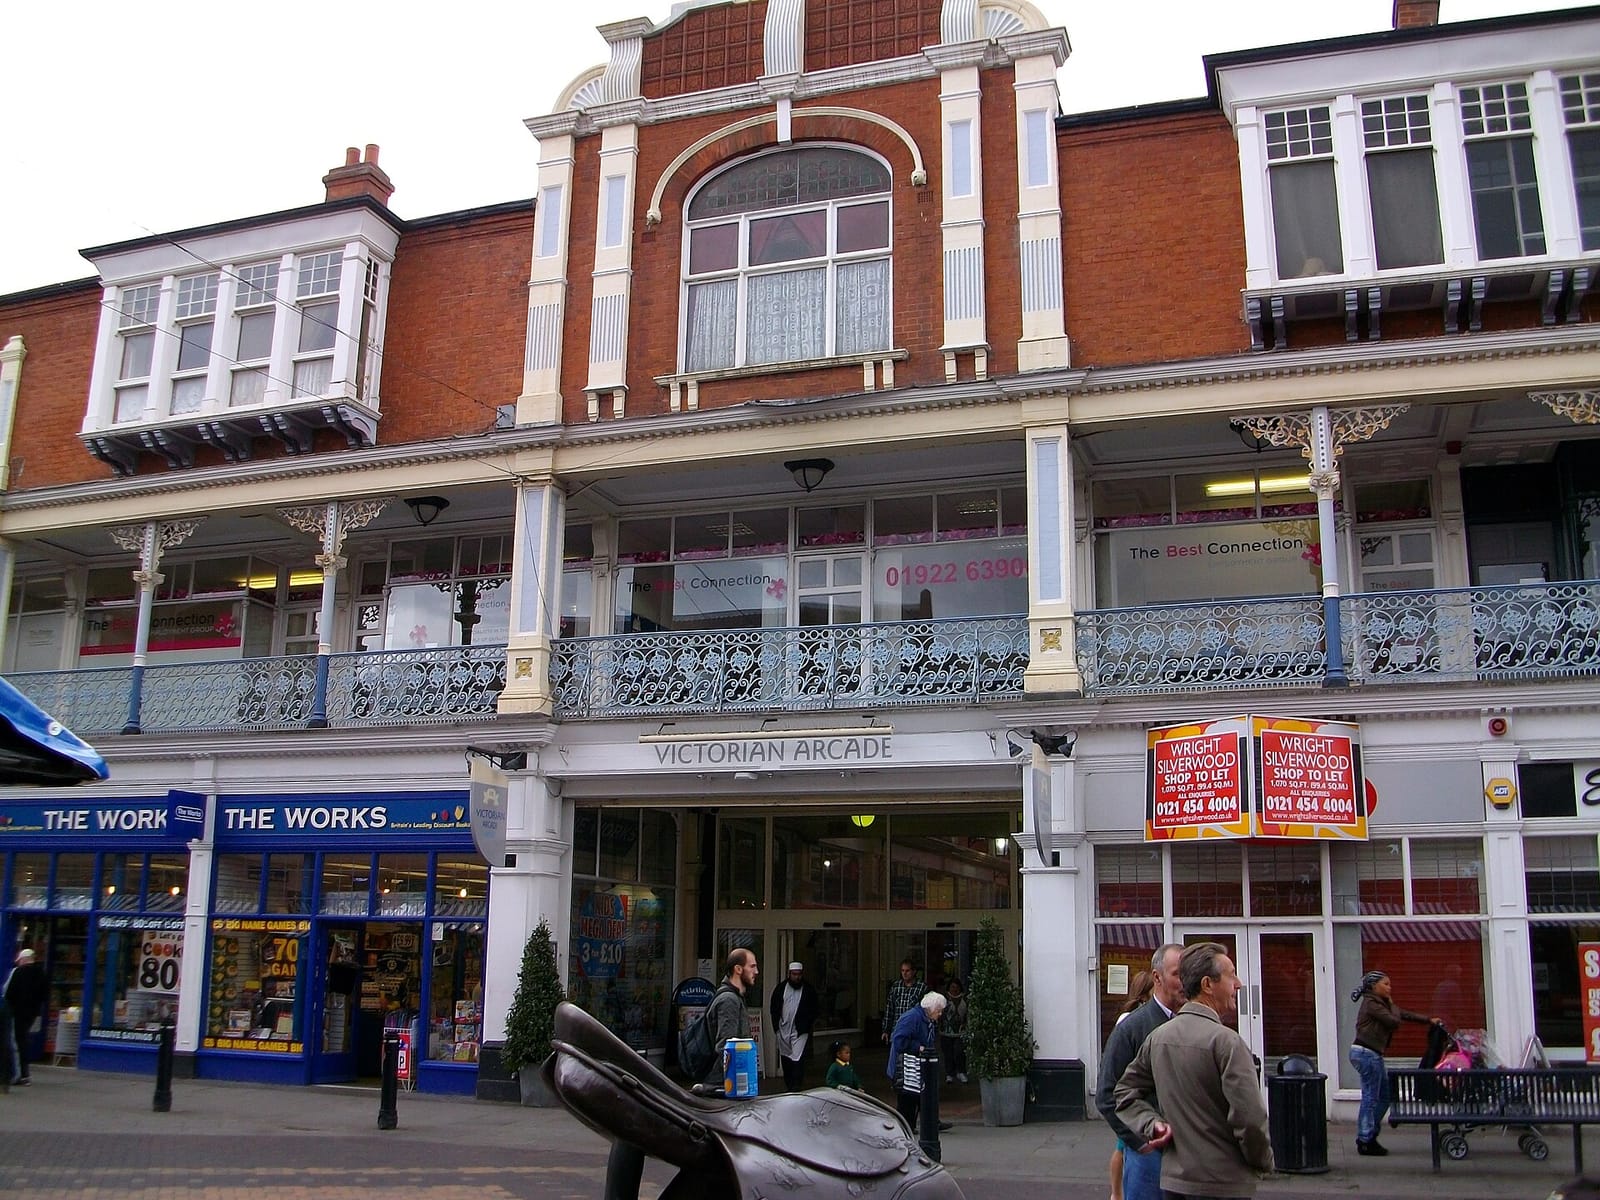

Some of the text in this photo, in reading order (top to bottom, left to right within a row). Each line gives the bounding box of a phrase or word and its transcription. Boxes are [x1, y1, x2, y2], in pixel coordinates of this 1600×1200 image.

[1130, 537, 1304, 560] The Best Connection
[886, 556, 1028, 587] 01922 6390
[627, 582, 651, 593] The
[691, 574, 771, 589] Connection
[88, 619, 109, 632] The
[153, 613, 215, 628] onnection
[654, 737, 893, 765] VICTORIAN ARCADE
[1170, 737, 1222, 757] WRIGHT
[1279, 735, 1334, 753] WRIGHT
[1157, 752, 1236, 774] SILVERWOOD
[1265, 751, 1349, 770] SILVERWOOD
[1164, 768, 1229, 785] SHOP TO LET
[1273, 767, 1344, 782] SHOP TO LET
[1157, 796, 1238, 816] 0121 454 4004
[1266, 795, 1353, 813] 0121 454 4004
[44, 809, 168, 830] THE WORK
[224, 805, 388, 830] THE WORKS
[242, 920, 266, 930] NAME
[267, 921, 297, 930] GAMES
[579, 916, 607, 939] MEGA
[582, 942, 591, 963] 3
[600, 943, 622, 964] £10
[217, 1038, 232, 1049] BIG
[233, 1040, 257, 1050] NAME
[258, 1041, 289, 1052] GAMES
